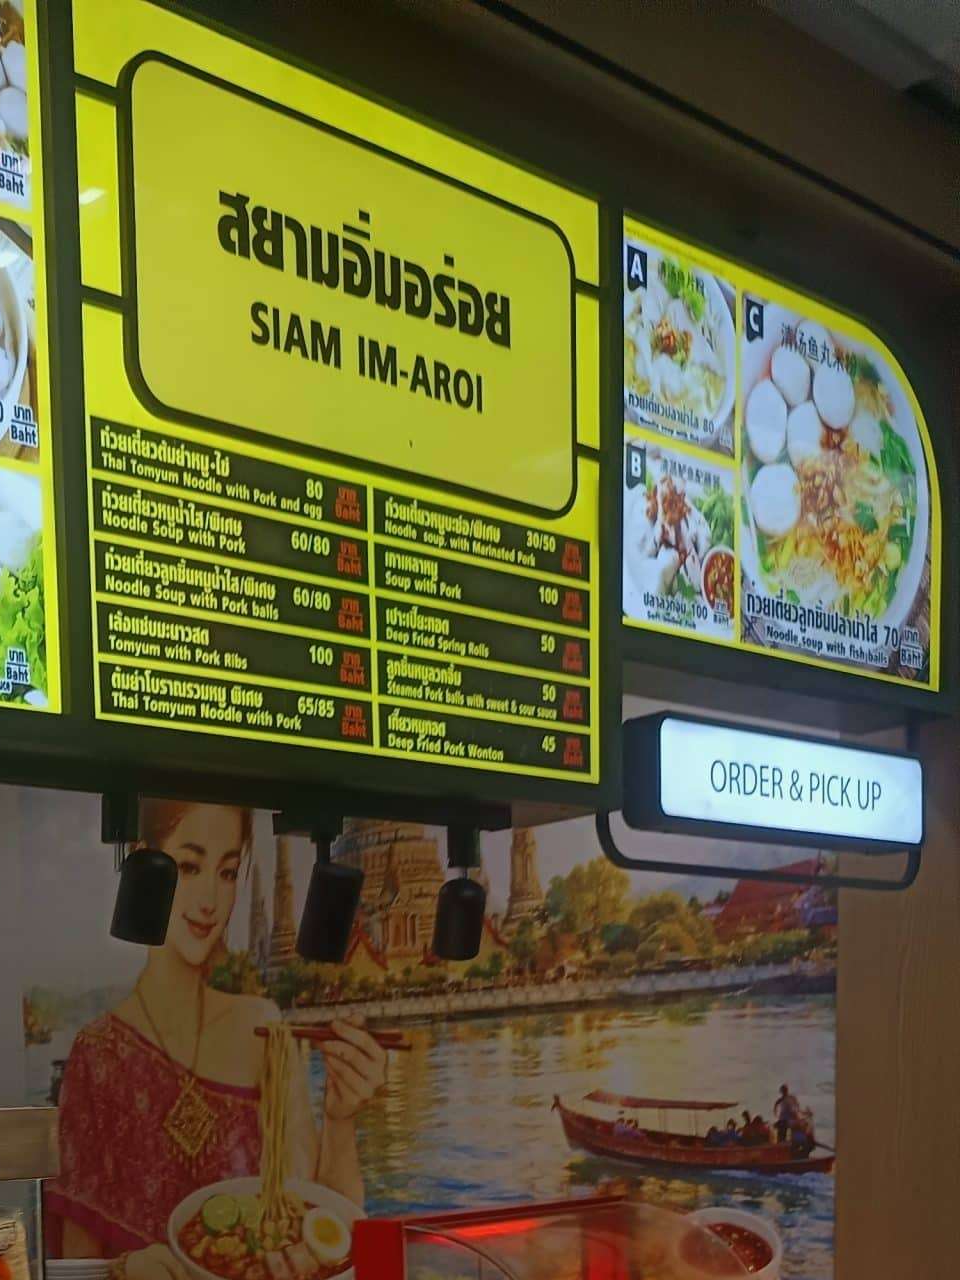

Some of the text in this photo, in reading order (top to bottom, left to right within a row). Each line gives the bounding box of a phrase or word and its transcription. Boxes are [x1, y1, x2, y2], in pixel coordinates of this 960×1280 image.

[218, 190, 511, 349] สยามอิ่มอร่อย
[631, 254, 644, 282] A
[749, 306, 759, 332] C
[251, 301, 483, 414] SIAM IM-AROI
[11, 424, 36, 444] Baht
[631, 451, 641, 478] B
[102, 452, 322, 520] Thai Tomyum Noodle with Pork and egg
[306, 478, 323, 500] 80
[103, 510, 246, 554] Noodle Soup with Pork
[292, 531, 330, 556] 60/80
[385, 520, 535, 567] Noodle Pork
[105, 575, 279, 620] Noodle Soup with Pork balls
[385, 571, 461, 600] Soup with Pork
[539, 586, 558, 605] 100
[293, 587, 331, 611] 60/80
[691, 604, 707, 620] 100
[386, 627, 489, 658] Deep Fried Spring Rolls
[541, 634, 555, 653] 50
[767, 626, 798, 643] Noodle
[802, 637, 823, 651] soup
[827, 641, 845, 656] with
[850, 644, 865, 660] fish
[884, 626, 898, 650] 70
[109, 635, 247, 669] Tomyum with Pork Ribs
[310, 645, 333, 666] 100
[902, 650, 922, 666] Baht
[7, 665, 29, 681] Baht
[543, 684, 556, 702] 50
[112, 692, 301, 731] Thai Tomyum Noodle with Pork
[298, 696, 334, 718] 65/85
[388, 733, 464, 756] Deep Pork
[542, 735, 556, 752] 45
[711, 760, 882, 810] ORDER & PICK UP
